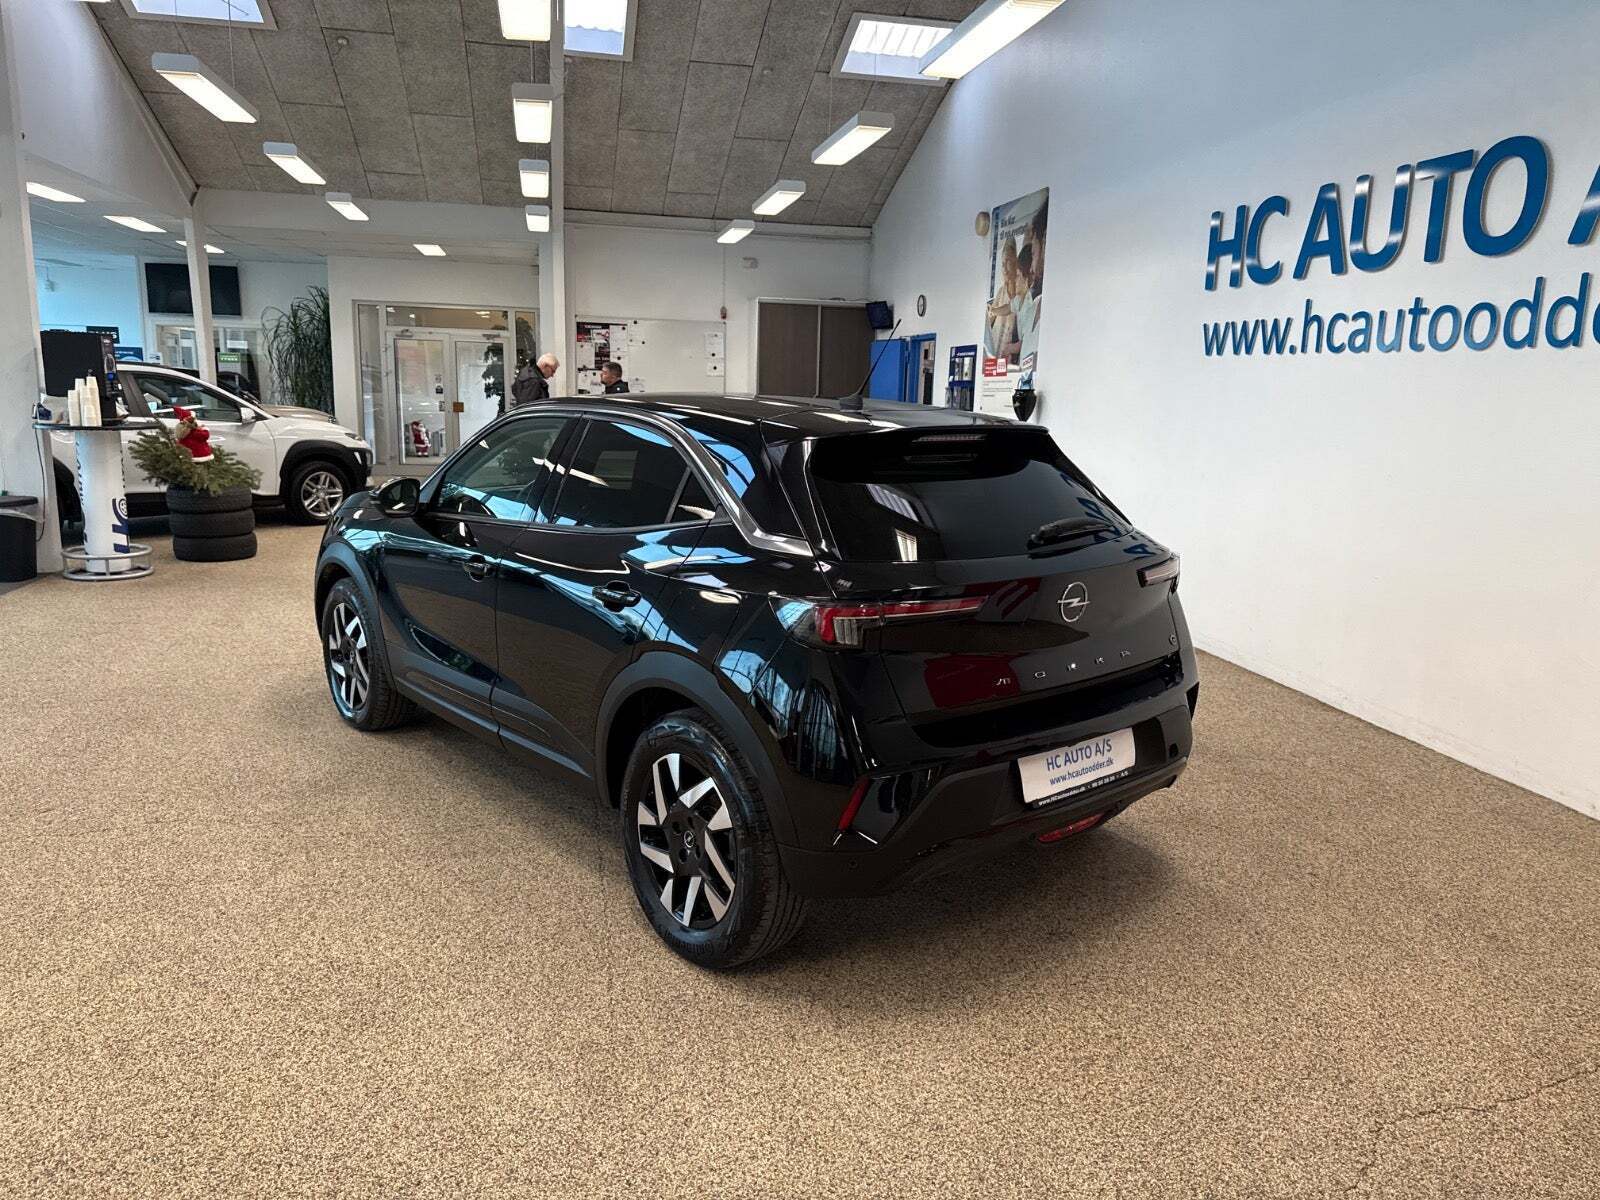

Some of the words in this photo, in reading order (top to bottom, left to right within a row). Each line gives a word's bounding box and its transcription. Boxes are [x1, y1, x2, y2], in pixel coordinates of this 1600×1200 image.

[1204, 195, 1289, 291] HC
[1293, 135, 1552, 281] AUTO
[1203, 272, 1600, 357] www.hcautoodd
[1046, 754, 1061, 771] HC
[1064, 745, 1092, 766] AUTO
[1095, 738, 1112, 757] A/S
[1050, 756, 1114, 785] www.hcautoodder.dk
